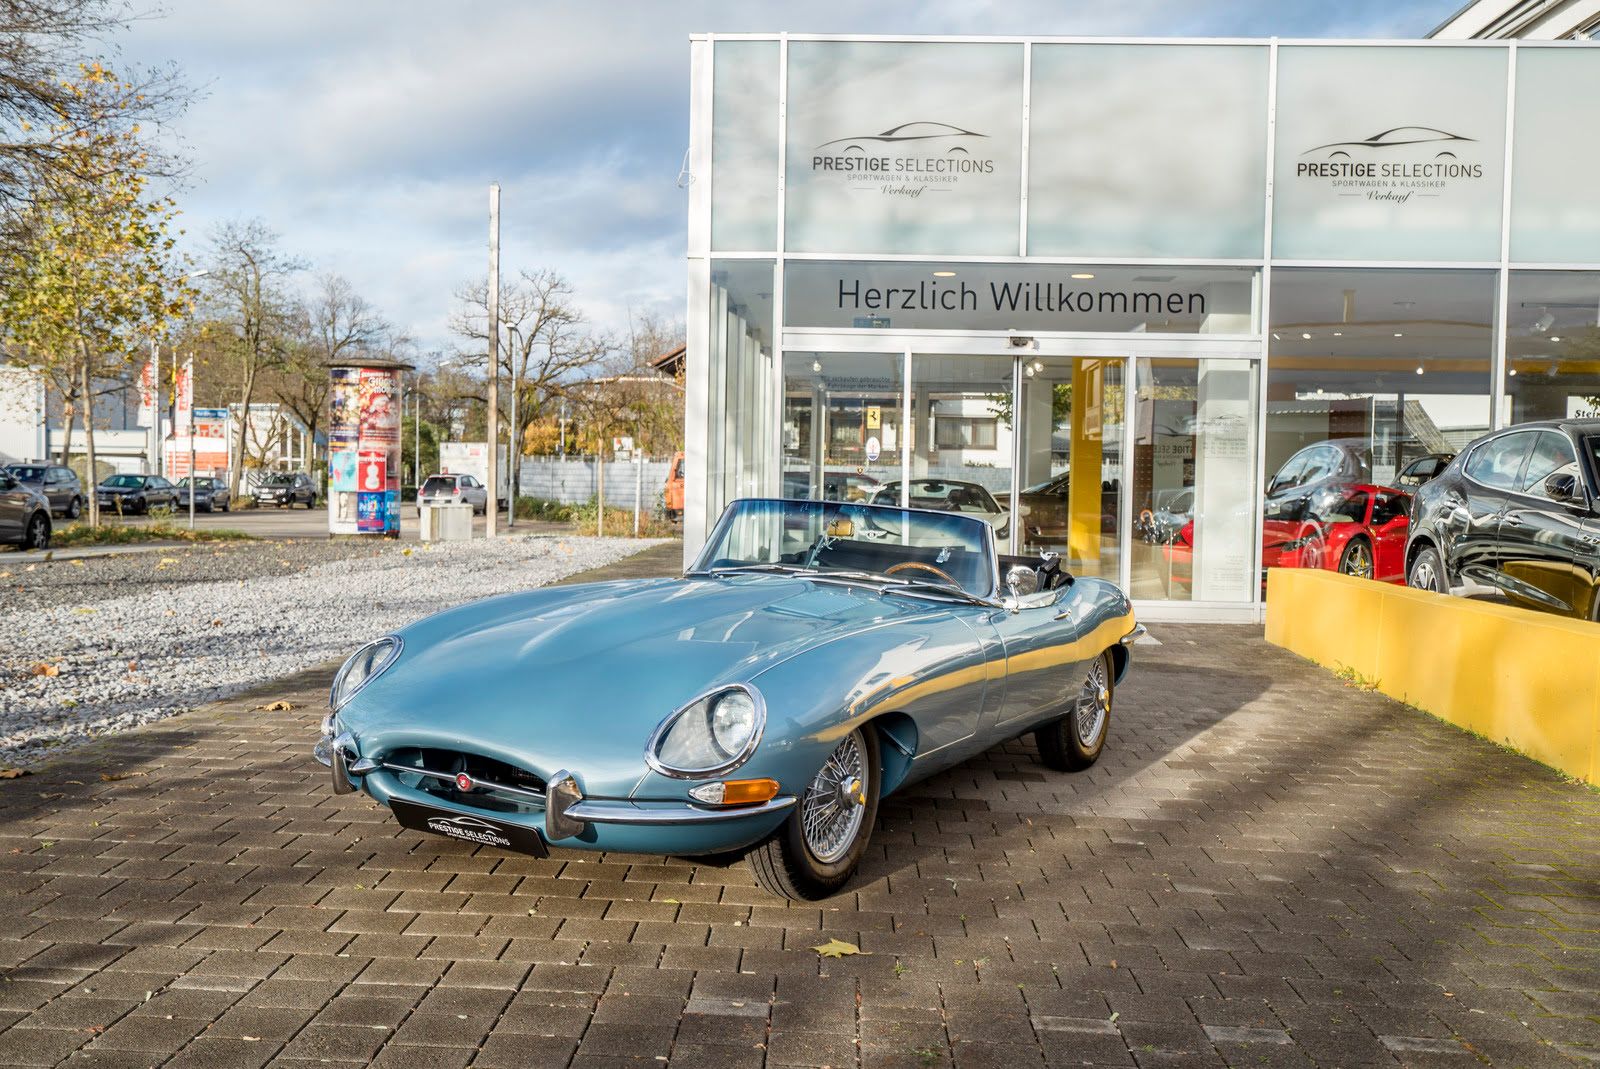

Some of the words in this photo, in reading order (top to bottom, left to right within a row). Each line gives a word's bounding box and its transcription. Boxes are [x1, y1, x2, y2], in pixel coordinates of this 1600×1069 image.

[812, 156, 890, 172] PRESTIGE
[895, 158, 994, 173] SELECTIONS
[1297, 163, 1376, 177] PRESTIGE
[1381, 163, 1483, 178] SELECTIONS
[847, 174, 901, 182] SPORTWAGEN
[913, 175, 958, 183] KLASSIKER
[1400, 180, 1446, 188] KLASSIKER
[880, 185, 928, 198] Verkauf
[1366, 190, 1415, 203] Verkauf
[838, 279, 978, 311] Herzlich
[990, 282, 1206, 314] Willkommen
[427, 822, 465, 836] PRESTIGE
[465, 829, 511, 846] SELECTIONS
